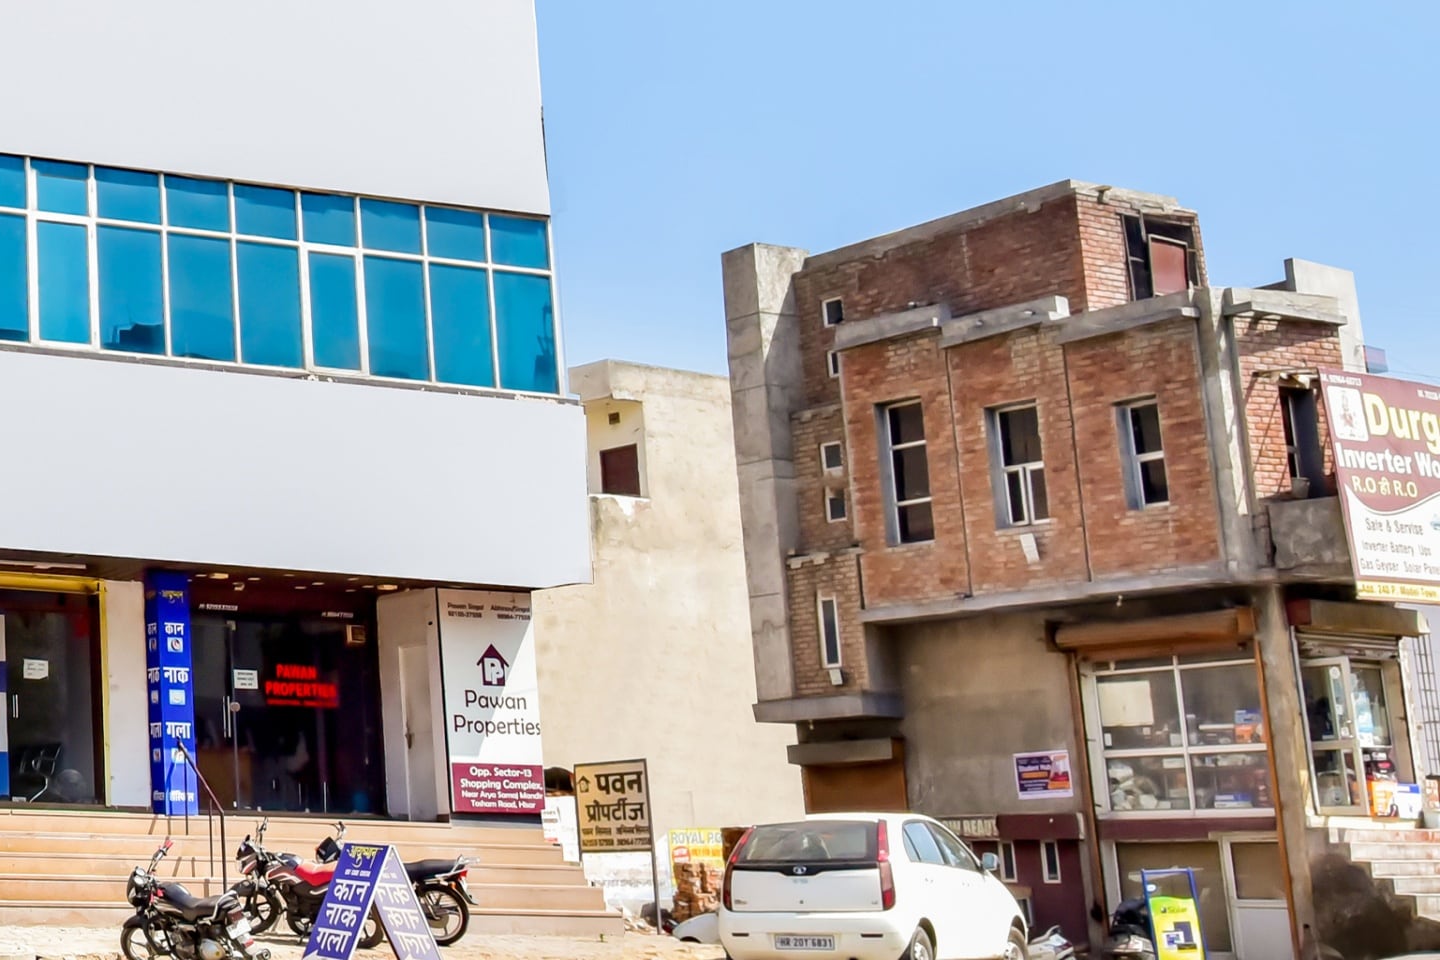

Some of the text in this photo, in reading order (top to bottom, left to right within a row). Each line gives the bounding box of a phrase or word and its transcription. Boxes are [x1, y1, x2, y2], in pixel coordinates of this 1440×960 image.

[1335, 443, 1412, 475] Inverter
[164, 622, 184, 636] कान
[163, 666, 190, 684] नाक
[464, 689, 527, 710] Pawan
[165, 721, 191, 739] गला
[453, 715, 541, 736] Properties
[469, 766, 532, 777] Opp. Sector-13
[460, 778, 501, 790] Shopping
[594, 771, 643, 795] पवन
[480, 791, 497, 799] Arya
[585, 797, 645, 823] प्रोपर्टीज
[670, 831, 705, 844] ROYAL
[334, 879, 371, 903] कान
[326, 903, 362, 928] नाक
[316, 928, 352, 953] गला
